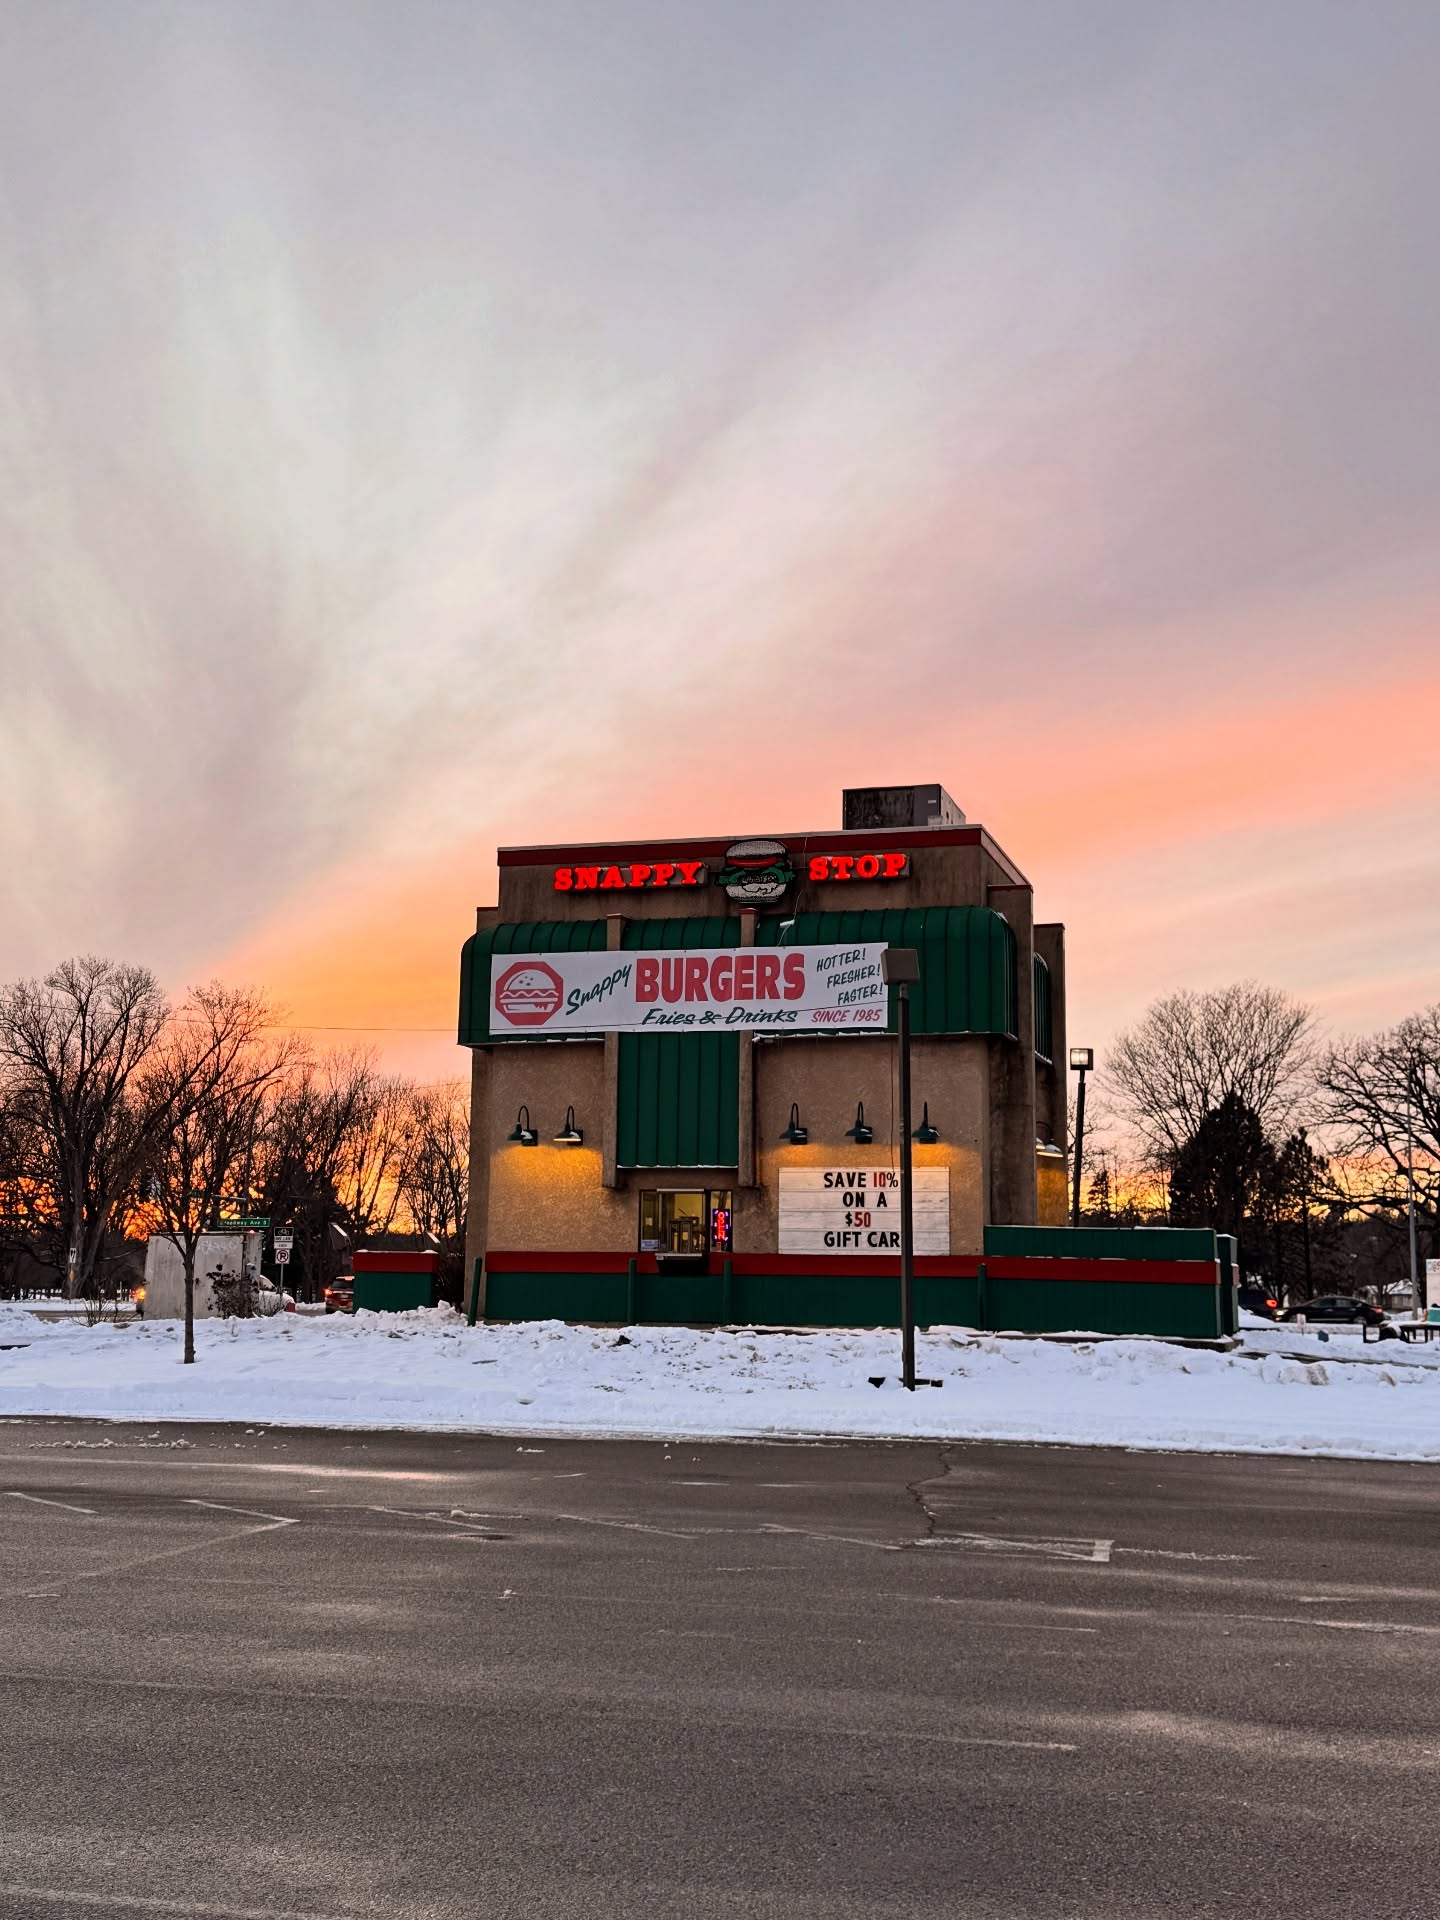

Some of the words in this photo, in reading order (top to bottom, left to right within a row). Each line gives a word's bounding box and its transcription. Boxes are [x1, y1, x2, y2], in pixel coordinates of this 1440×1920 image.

[554, 861, 702, 890] SNAPPY
[809, 853, 906, 881] STOP
[817, 947, 866, 972] HOTTER!
[565, 964, 632, 1015] Snappy
[636, 953, 805, 1003] BURGERS
[827, 963, 881, 988] FRESHER!
[837, 982, 883, 1005] FASTER!
[641, 1008, 696, 1025] Fries
[699, 1010, 721, 1025] &
[725, 1006, 799, 1024] Drinks
[811, 1009, 850, 1023] SINCE
[853, 1009, 883, 1022] 1985
[823, 1171, 867, 1188] SAVE
[873, 1171, 899, 1188] 10%
[842, 1191, 865, 1208] ON
[876, 1191, 888, 1208] A
[717, 1211, 726, 1240] OPEN
[844, 1211, 872, 1228] $50
[823, 1231, 862, 1248] GIFT
[867, 1231, 900, 1248] CAR
